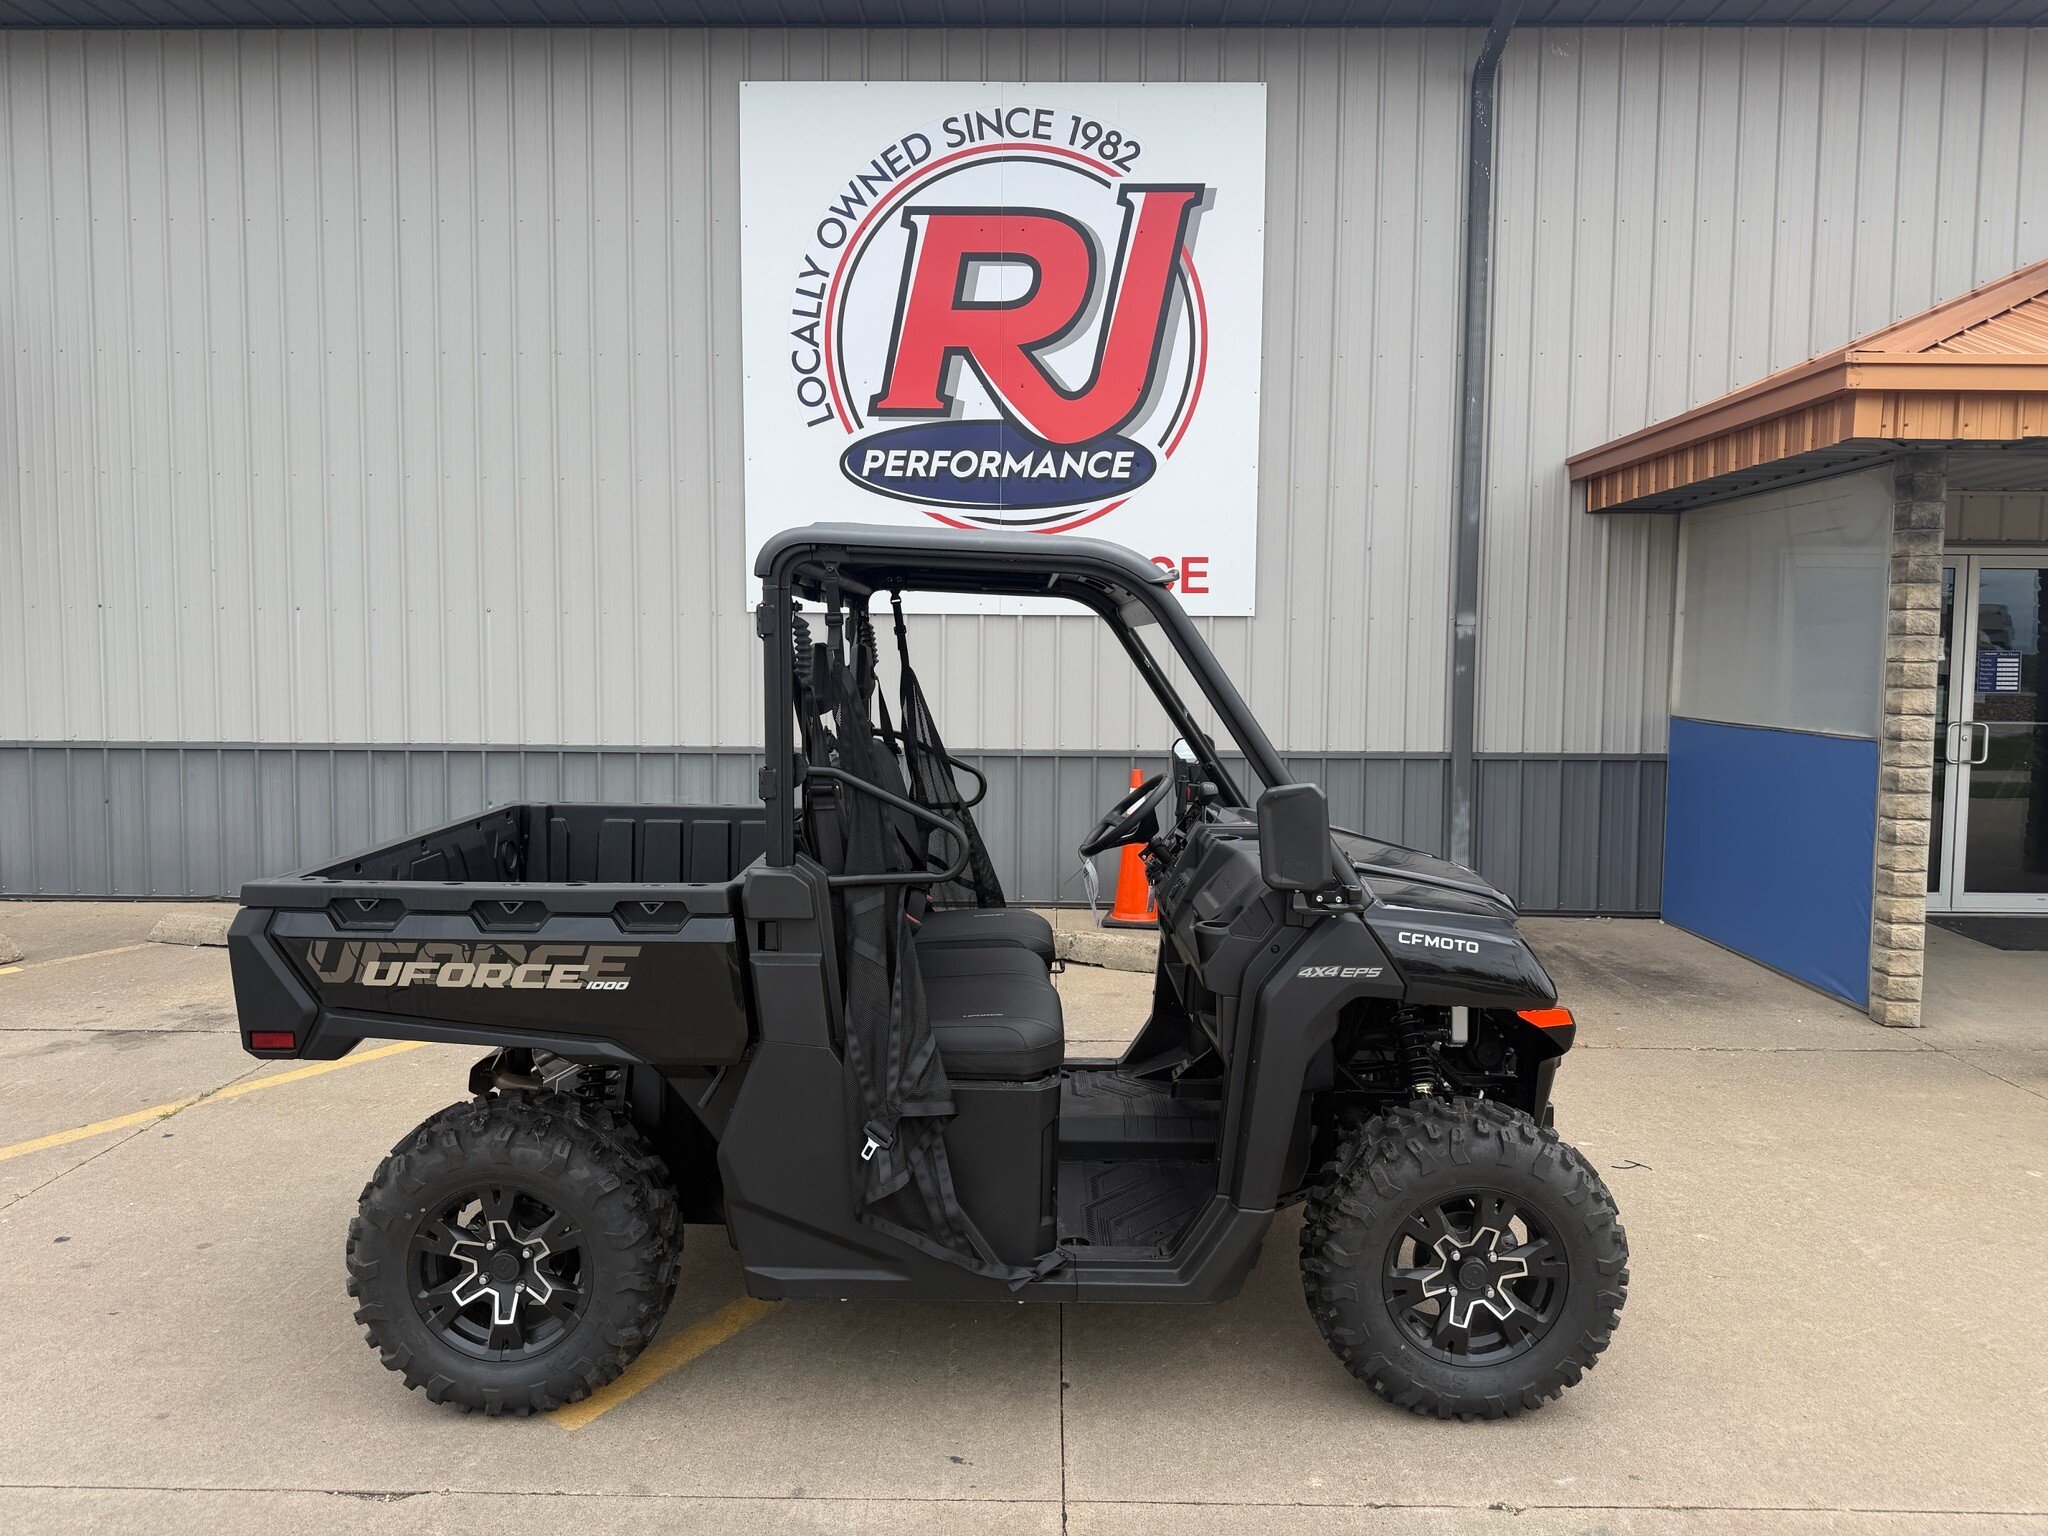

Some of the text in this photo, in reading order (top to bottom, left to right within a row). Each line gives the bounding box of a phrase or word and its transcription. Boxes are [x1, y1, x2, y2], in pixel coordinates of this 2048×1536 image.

[790, 107, 1142, 428] LOCALLY OWNED SINCE 1982
[867, 182, 1206, 445] RJ
[861, 449, 1135, 479] PERFORMANCE
[1398, 931, 1480, 954] CFMOTO
[361, 961, 630, 990] UFORCE 1000
[1340, 967, 1383, 978] EPS
